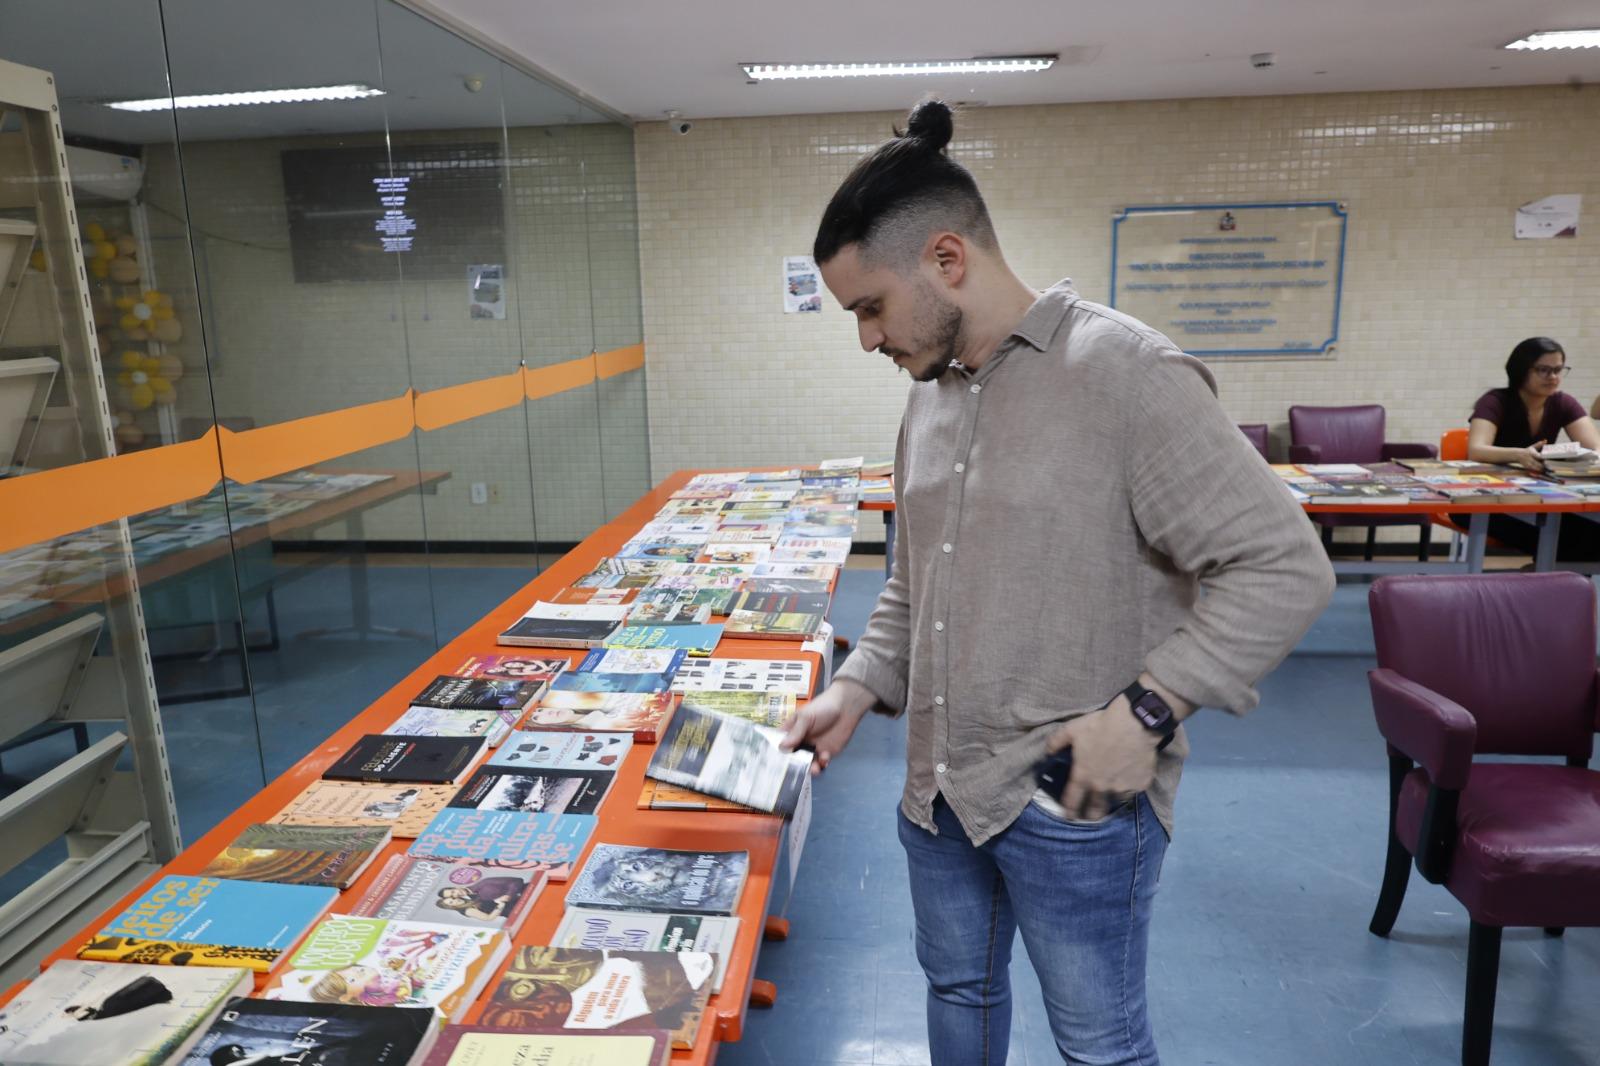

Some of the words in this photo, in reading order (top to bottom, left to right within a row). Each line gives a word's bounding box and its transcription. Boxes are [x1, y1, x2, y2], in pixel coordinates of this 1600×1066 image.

[102, 880, 188, 935] jeitos
[378, 862, 430, 919] CASAMENTO
[393, 871, 440, 920] BLINDADO
[138, 911, 181, 936] de
[299, 920, 352, 966] MONTEIRO
[320, 922, 375, 966] LOBATO
